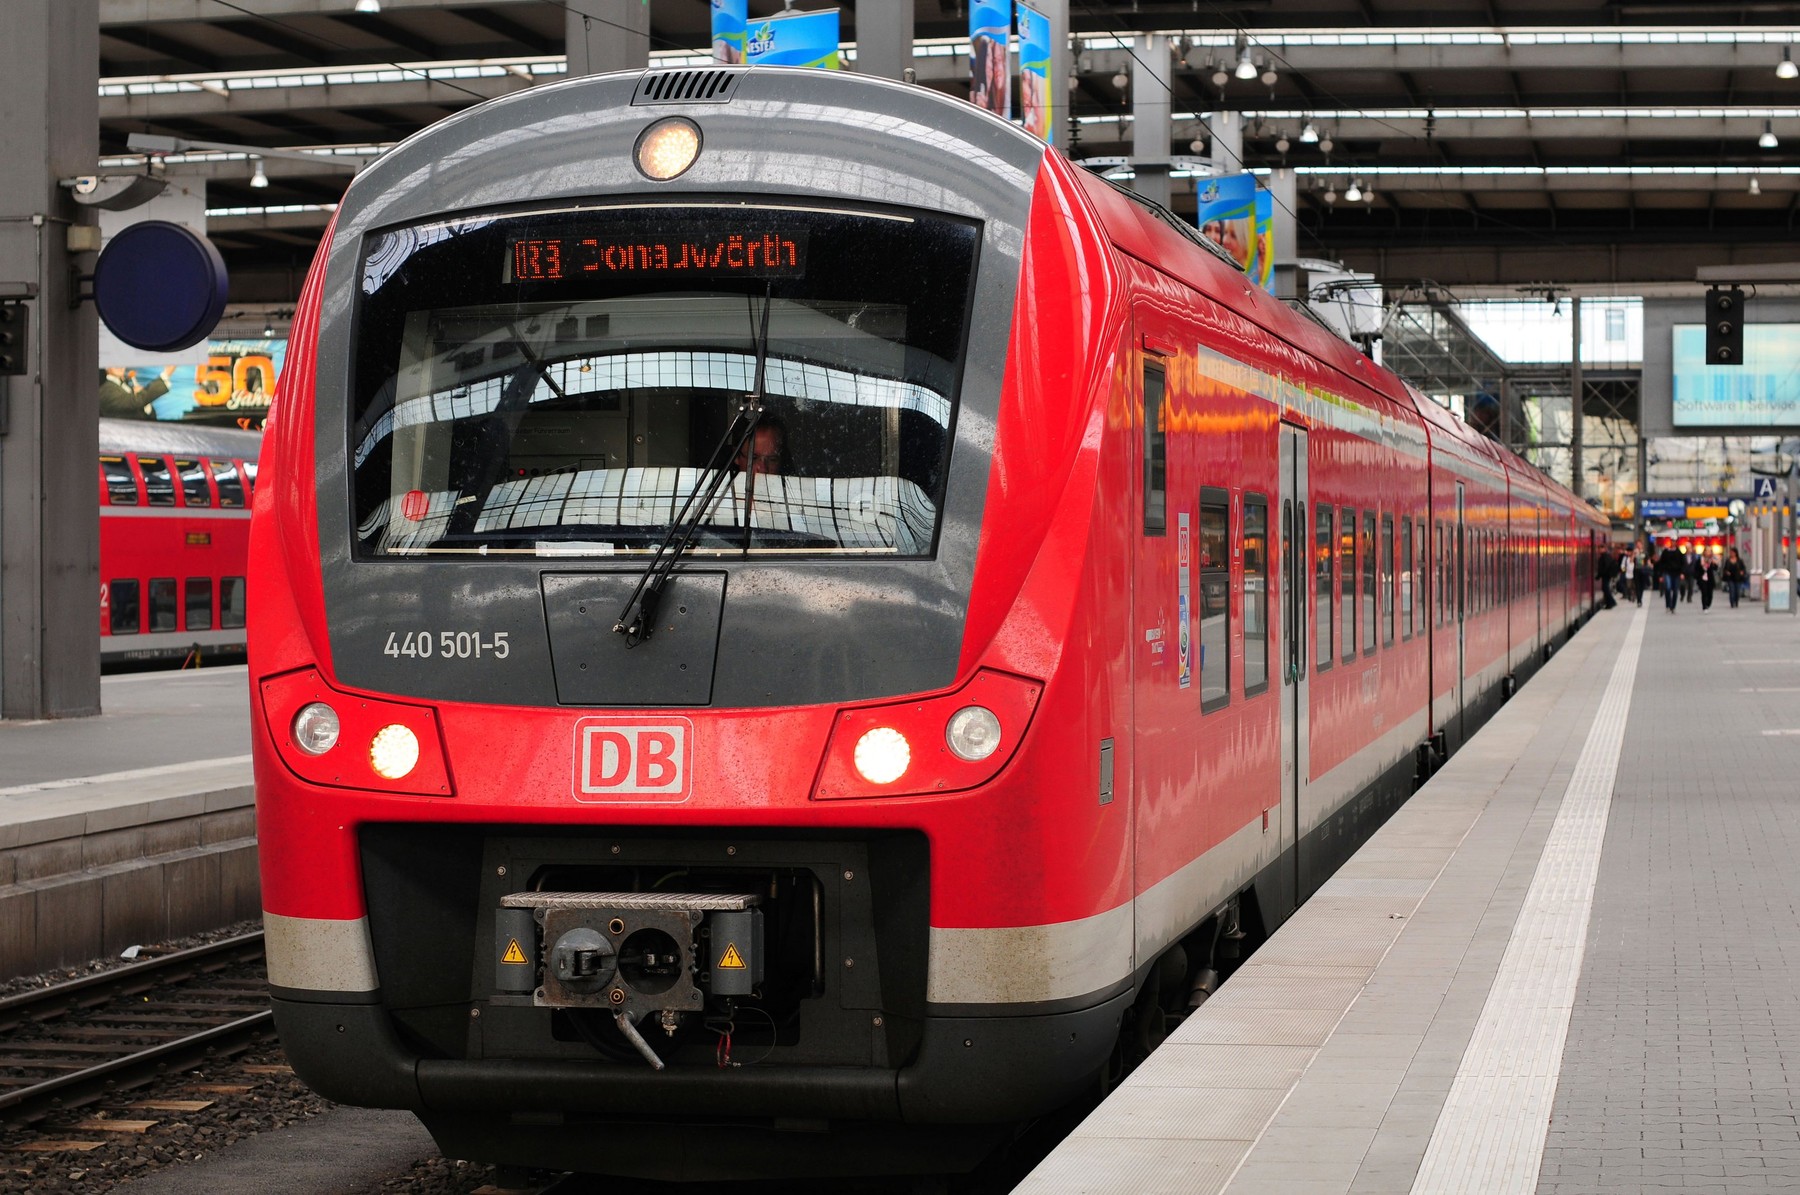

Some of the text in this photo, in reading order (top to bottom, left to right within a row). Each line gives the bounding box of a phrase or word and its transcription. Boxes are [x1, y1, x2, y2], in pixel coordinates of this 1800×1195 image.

[193, 355, 275, 406] 50
[1759, 479, 1774, 496] A
[100, 583, 108, 608] 2
[383, 631, 510, 659] 440 501-5
[588, 730, 678, 788] DB
